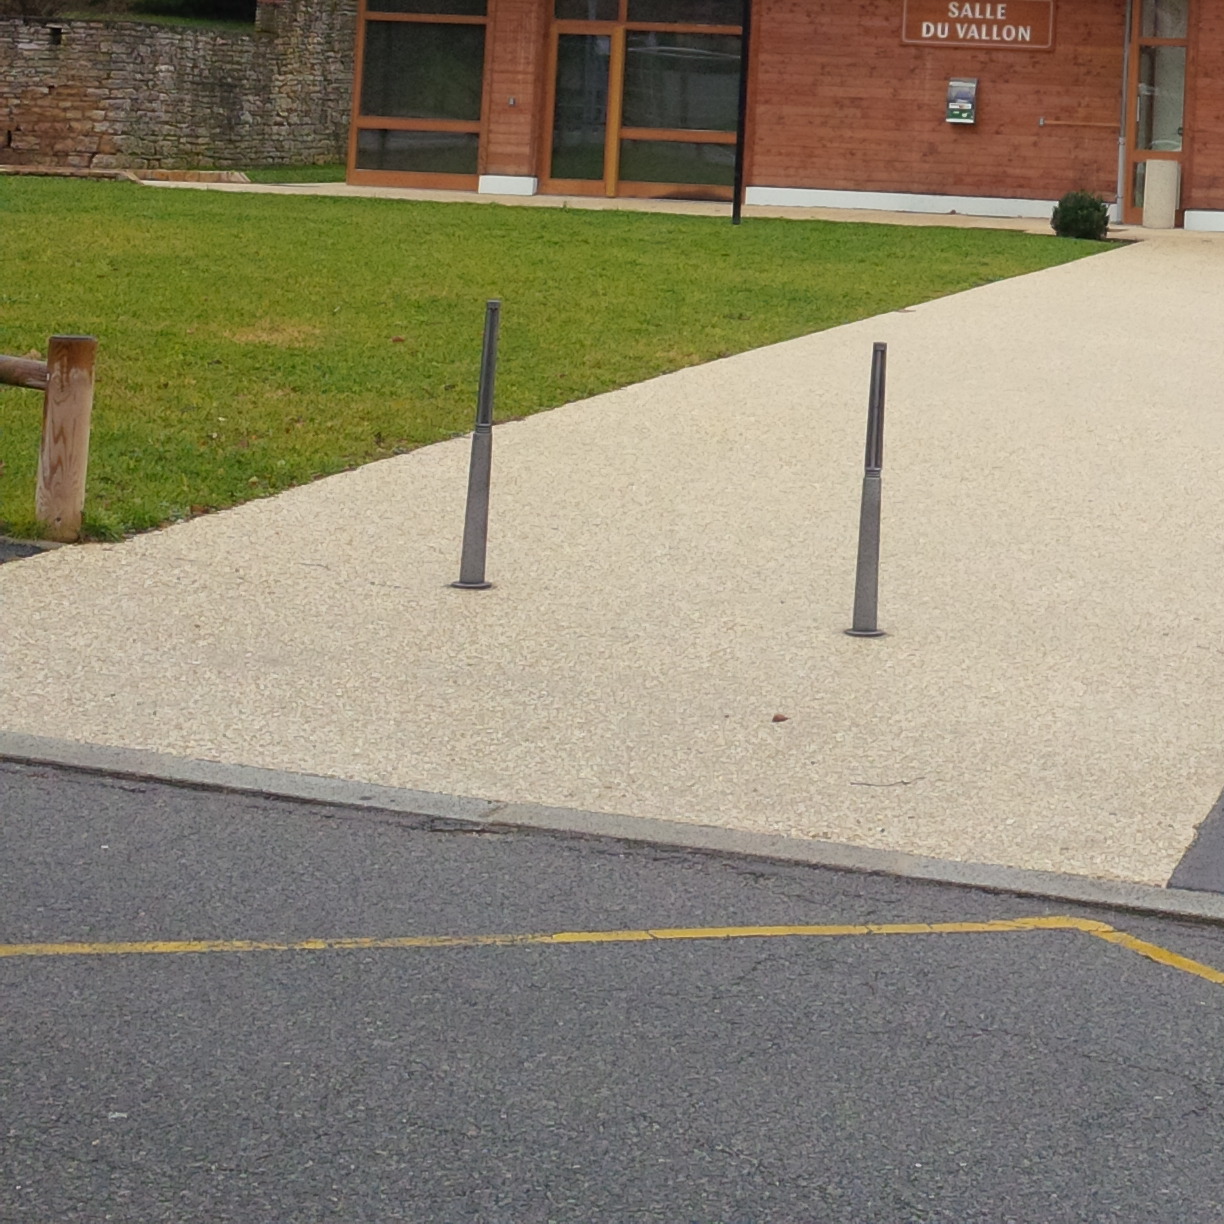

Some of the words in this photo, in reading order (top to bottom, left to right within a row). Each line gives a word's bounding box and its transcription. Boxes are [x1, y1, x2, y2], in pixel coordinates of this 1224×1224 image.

[948, 1, 1007, 20] SALLE
[921, 21, 949, 39] DU
[955, 23, 1031, 42] VALLON
